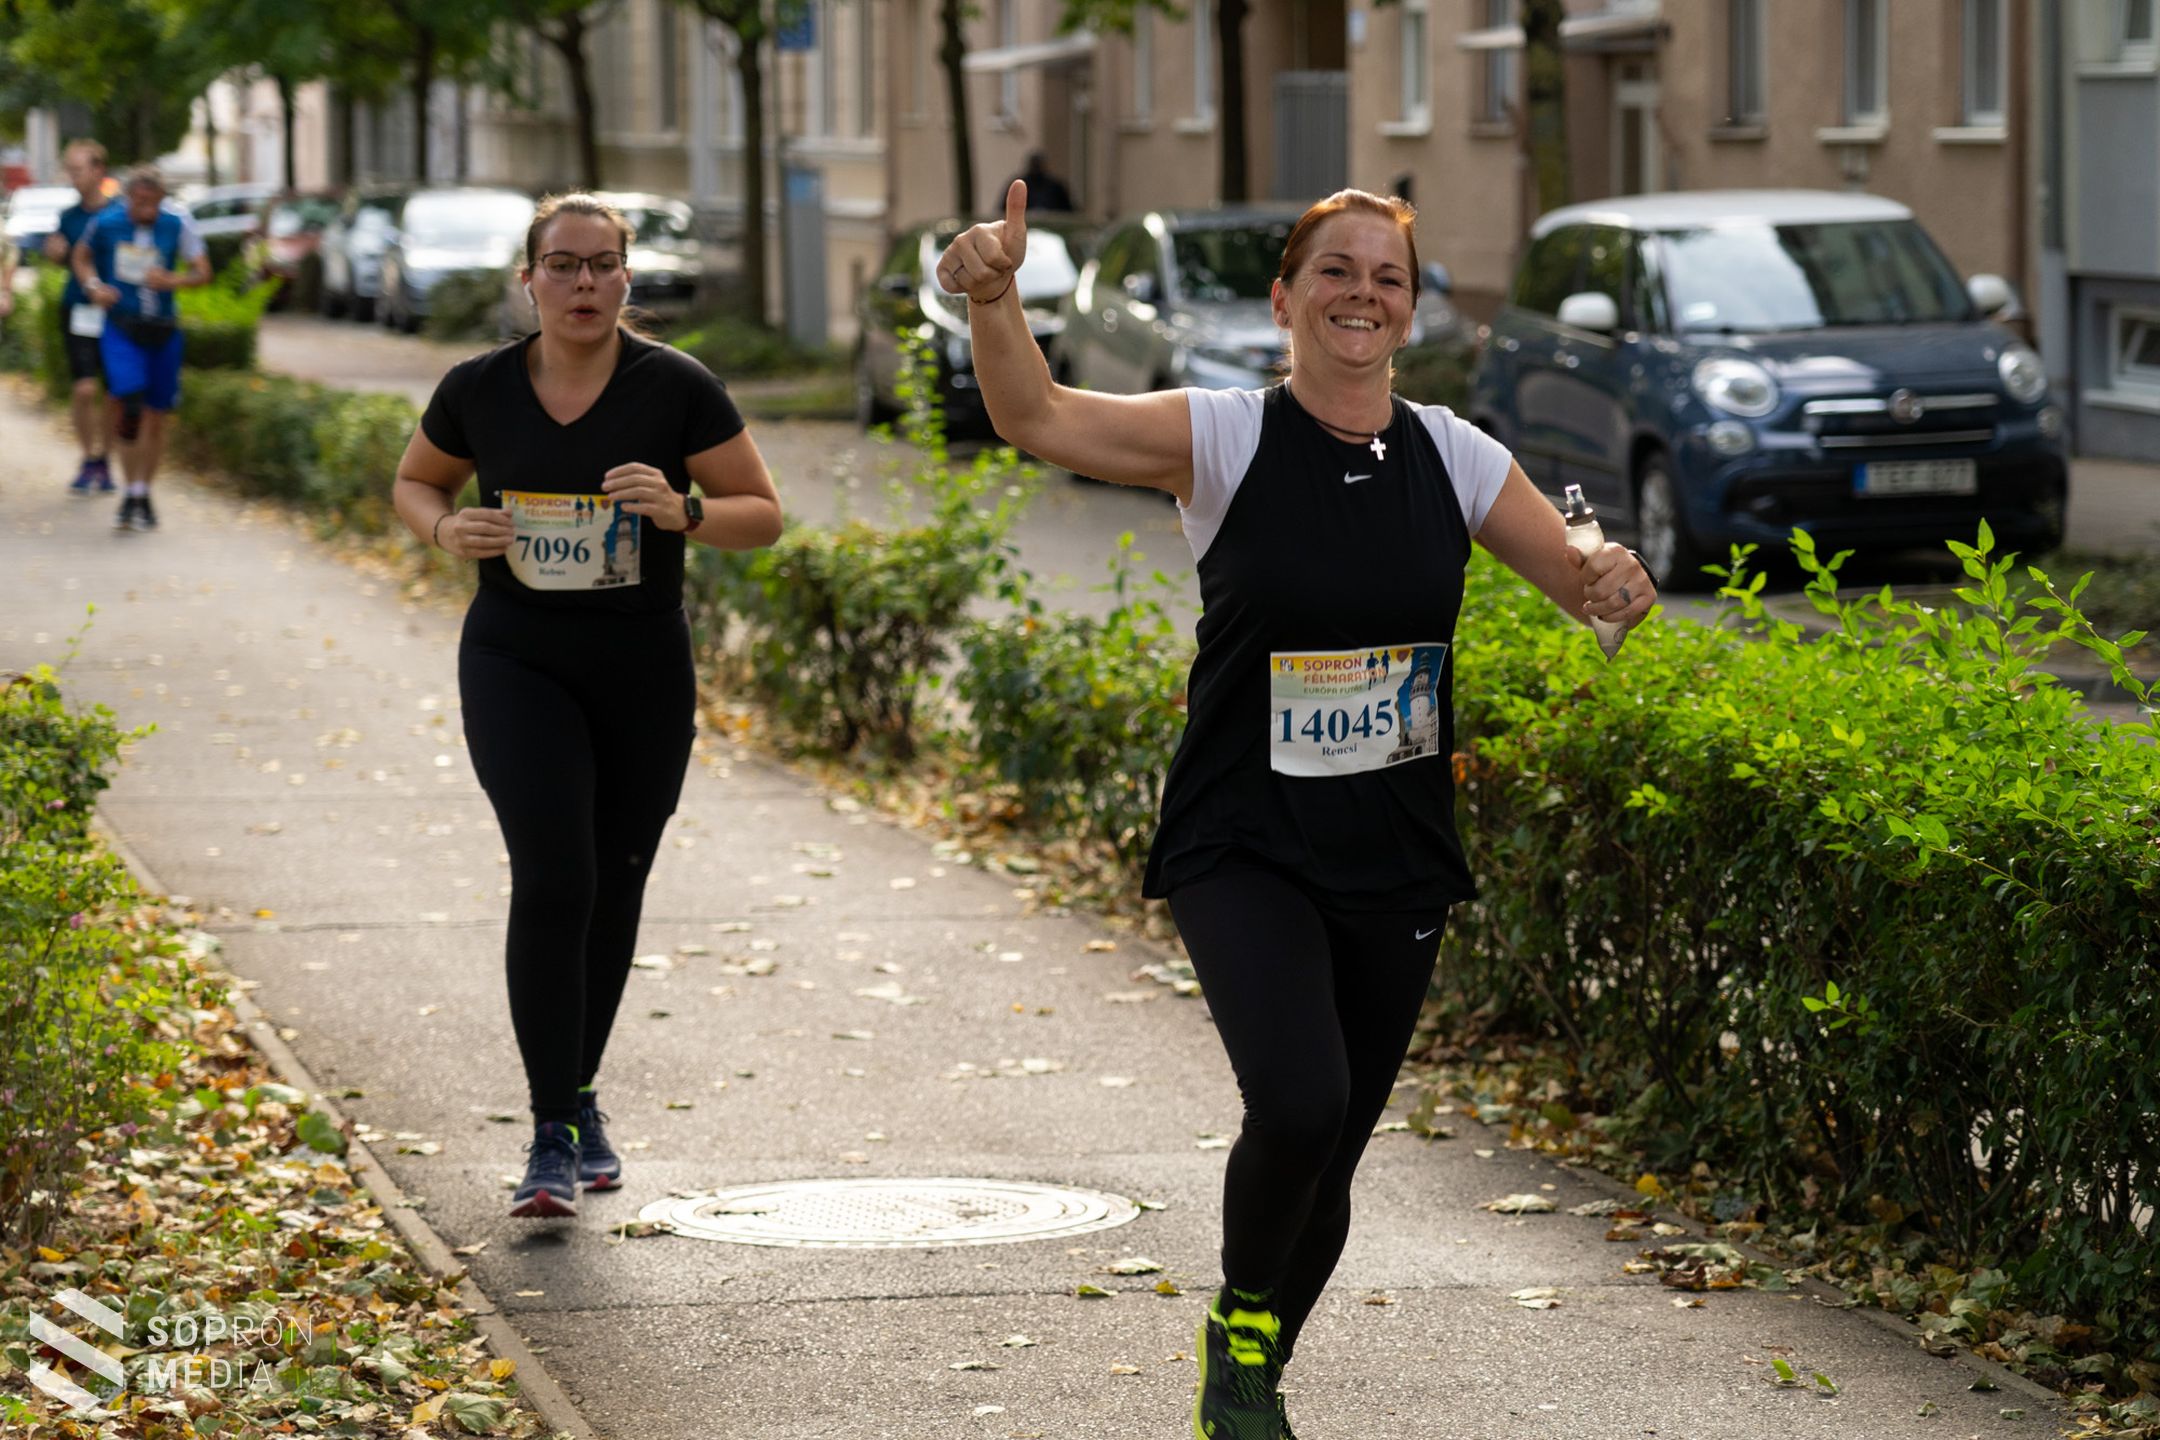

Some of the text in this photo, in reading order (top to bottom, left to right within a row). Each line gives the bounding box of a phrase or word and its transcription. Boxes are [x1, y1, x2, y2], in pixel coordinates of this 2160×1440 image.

[525, 497, 571, 507] SOPRON
[516, 535, 590, 564] 7096
[1303, 656, 1362, 672] SOPRON
[1279, 699, 1393, 743] 14045
